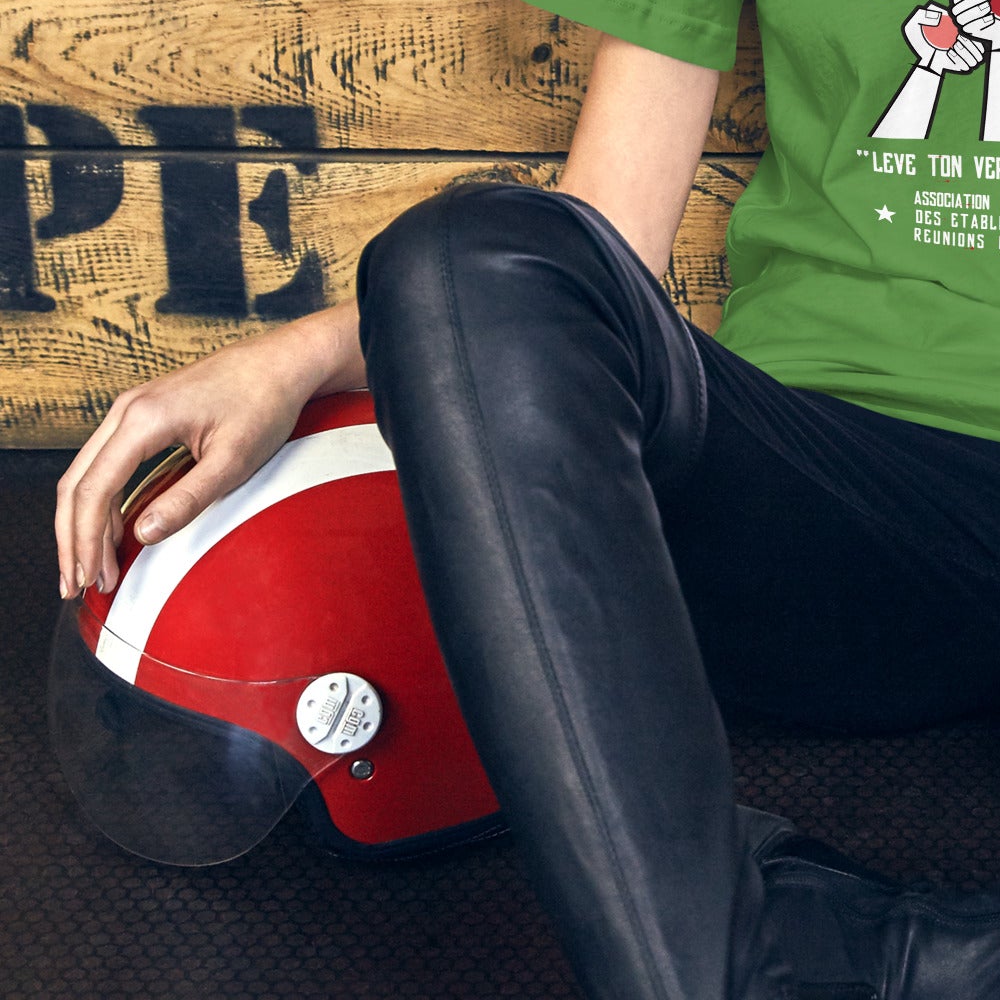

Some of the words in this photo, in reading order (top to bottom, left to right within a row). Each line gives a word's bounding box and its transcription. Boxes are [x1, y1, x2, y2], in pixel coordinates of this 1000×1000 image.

[928, 154, 962, 178] TON
[914, 190, 990, 210] ASSOCIATION
[915, 210, 941, 226] DES
[914, 228, 984, 249] REUNIONS
